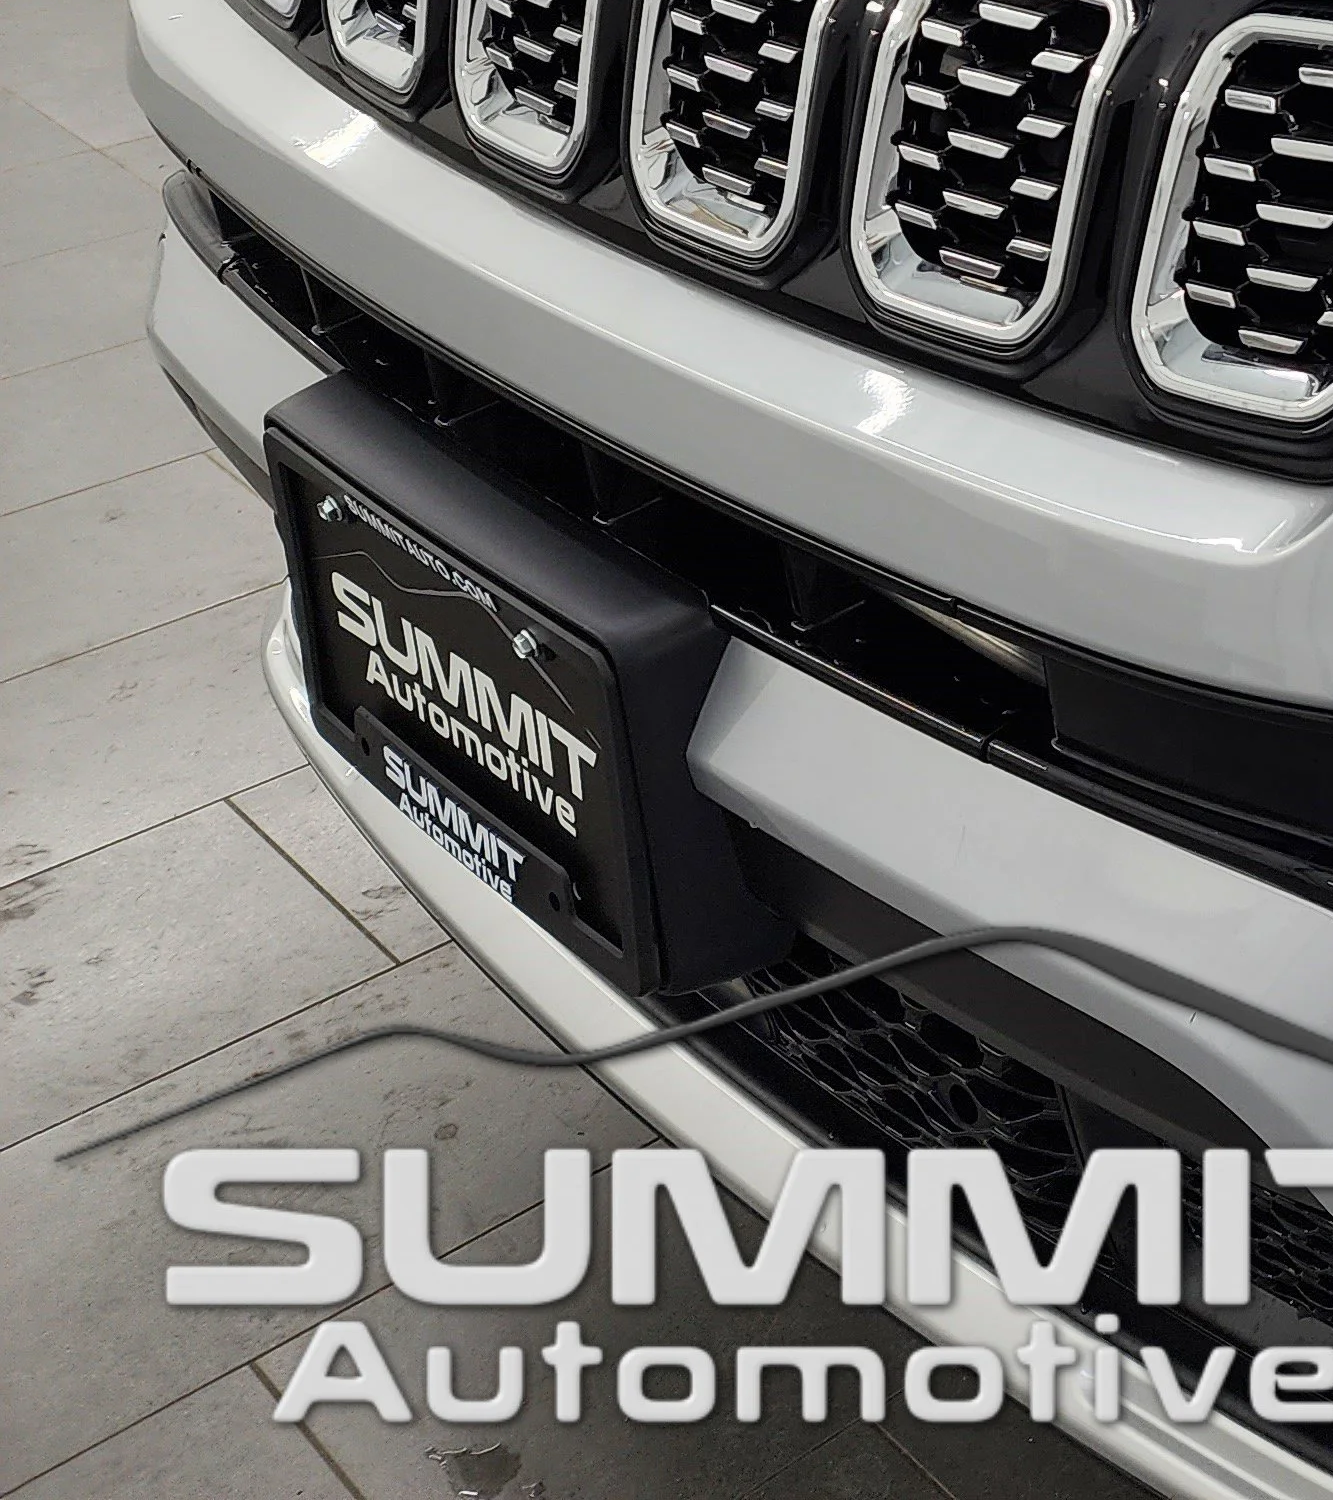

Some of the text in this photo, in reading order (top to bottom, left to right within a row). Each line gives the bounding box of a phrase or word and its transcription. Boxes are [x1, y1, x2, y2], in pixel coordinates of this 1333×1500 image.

[343, 494, 498, 613] SUMMITAUTO.COM
[331, 571, 597, 801] SUMMIT
[366, 649, 577, 837] Automotive
[383, 745, 524, 882] SUMMIT
[399, 792, 513, 903] Automotive
